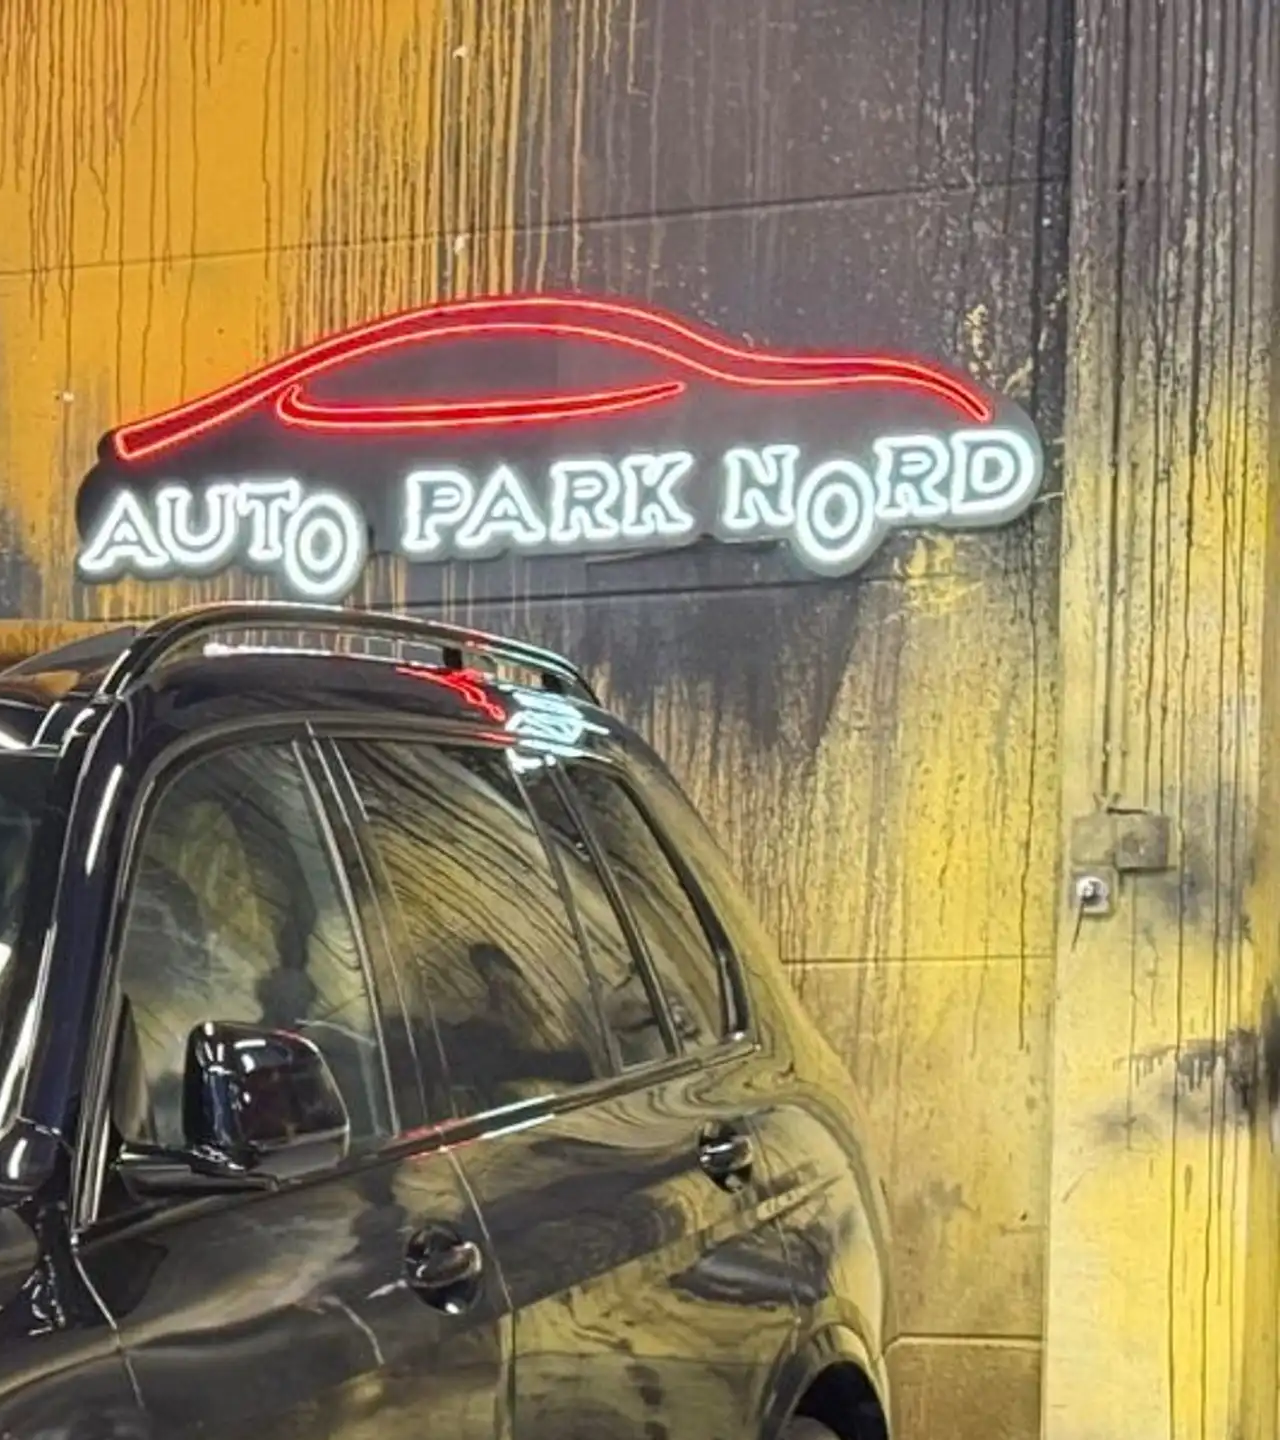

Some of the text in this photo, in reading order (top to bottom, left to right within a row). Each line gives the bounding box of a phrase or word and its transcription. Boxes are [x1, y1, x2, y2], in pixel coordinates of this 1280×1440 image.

[80, 428, 1036, 592] AUTO PARK NORD
